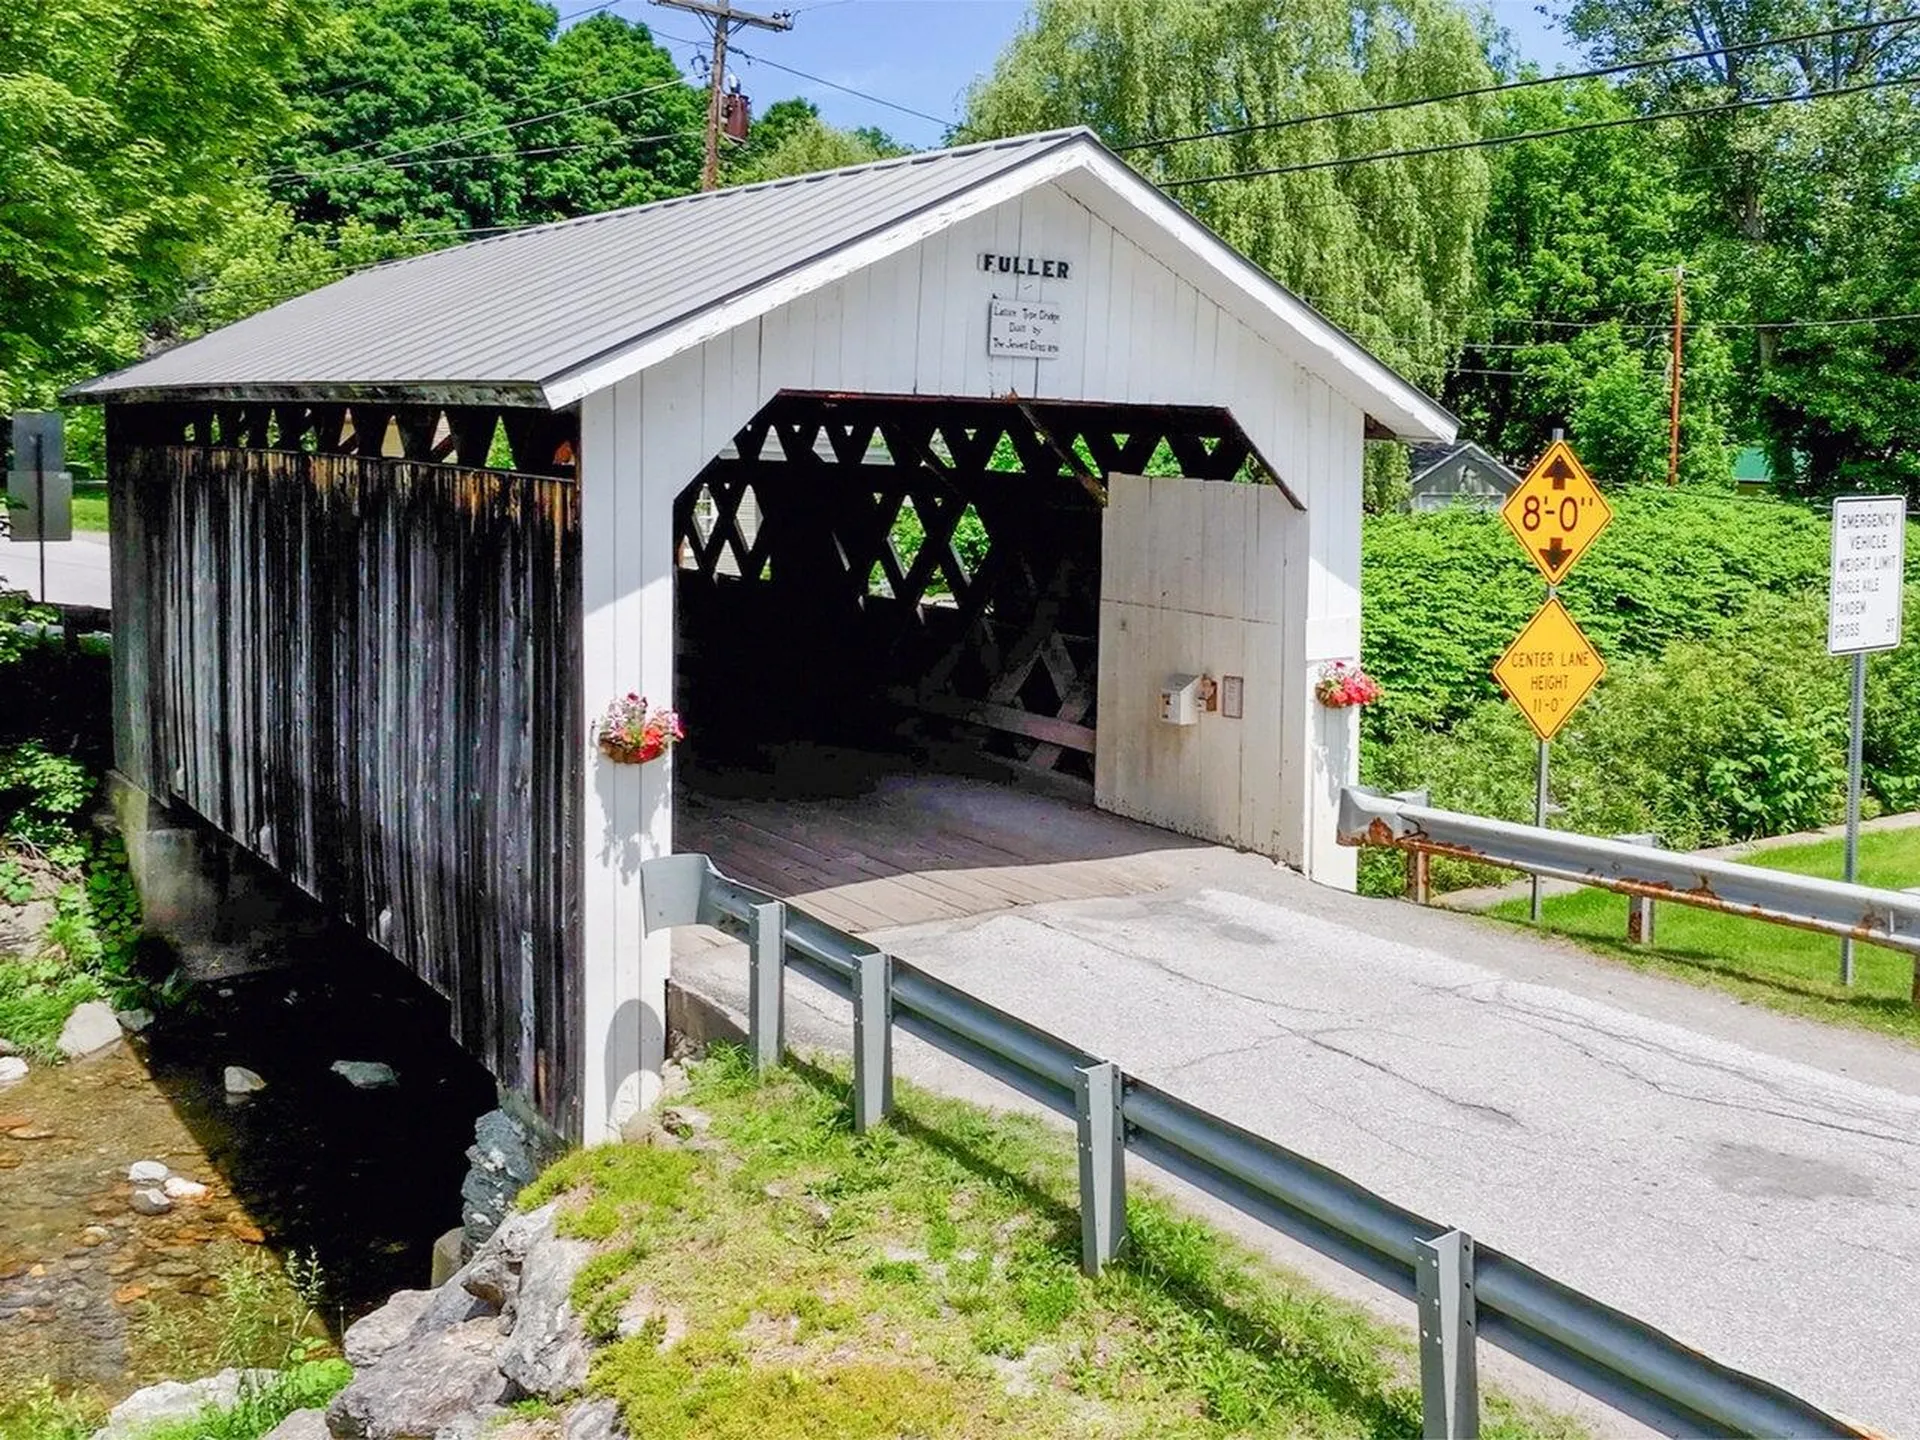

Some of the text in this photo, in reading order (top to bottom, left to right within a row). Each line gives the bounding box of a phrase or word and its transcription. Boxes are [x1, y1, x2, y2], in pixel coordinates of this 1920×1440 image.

[984, 254, 1069, 279] FULLER
[1842, 513, 1896, 529] EMERGENCY
[1850, 534, 1887, 550] VEHICLE
[1839, 554, 1896, 573] WEIGHT LIMIT
[1836, 577, 1879, 595] SINGLE AXLE
[1836, 600, 1866, 616] TANDEM
[1835, 622, 1860, 639] GROSS
[1511, 651, 1589, 668] CENTER LANE
[1531, 675, 1568, 691] HEIGHT
